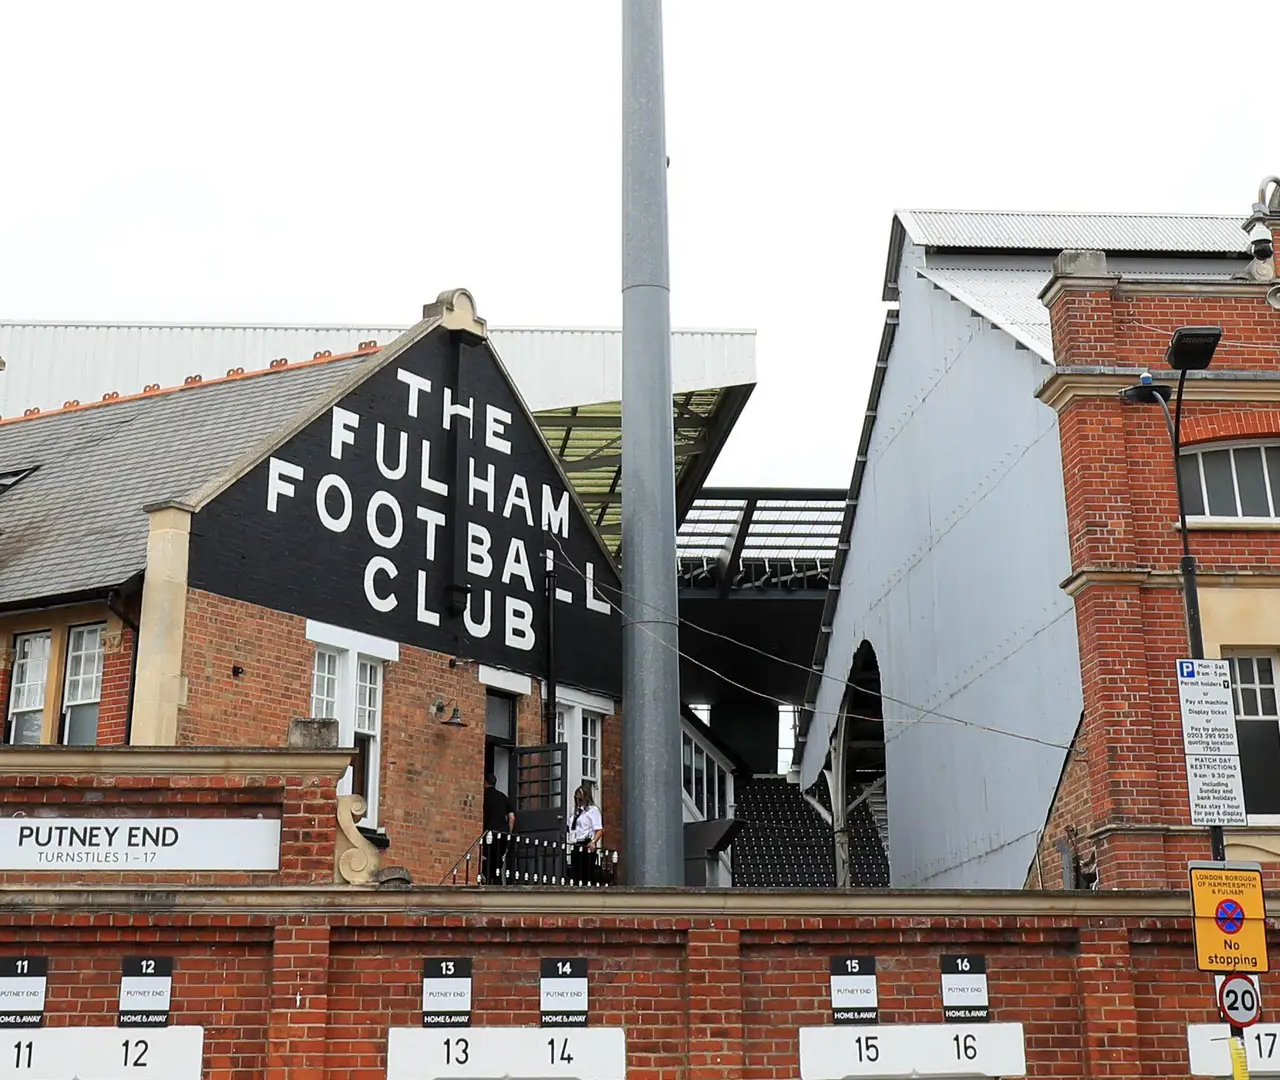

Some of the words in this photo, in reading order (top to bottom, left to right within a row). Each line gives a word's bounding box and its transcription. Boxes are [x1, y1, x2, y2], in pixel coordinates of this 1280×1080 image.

[397, 367, 512, 455] THE
[330, 405, 570, 539] FULHAM
[266, 456, 612, 616] FOOTBALL
[363, 555, 536, 652] CLUB
[1186, 698, 1196, 706] Pay
[1188, 708, 1209, 716] Display
[18, 826, 120, 847] PUTNEY
[127, 826, 179, 847] END
[38, 852, 119, 863] TURNSTILES
[124, 852, 129, 863] 1
[143, 852, 157, 863] 17
[1224, 940, 1240, 950] No
[16, 960, 28, 974] 11
[140, 960, 155, 974] 12
[440, 962, 455, 974] 13
[556, 962, 572, 974] 14
[846, 960, 860, 972] 15
[956, 958, 970, 971] 16
[1208, 954, 1258, 967] stopping
[1225, 989, 1255, 1012] 20
[946, 1010, 965, 1018] HOME
[14, 1040, 33, 1068] 11
[122, 1040, 149, 1067] 12
[444, 1038, 469, 1065] 13
[548, 1038, 574, 1064] 14
[855, 1036, 880, 1062] 15
[953, 1034, 977, 1060] 16
[1254, 1032, 1277, 1058] 17
